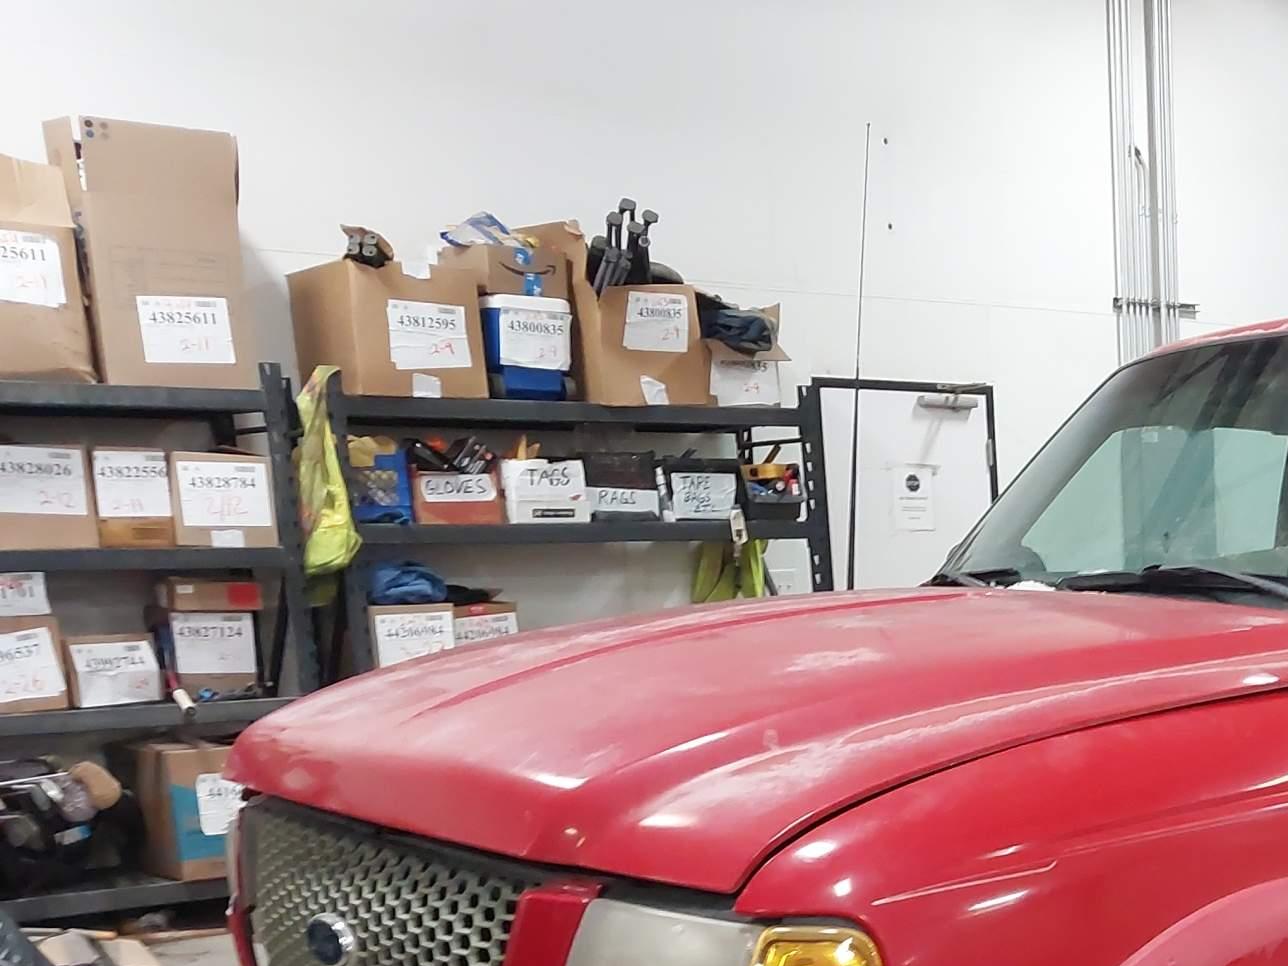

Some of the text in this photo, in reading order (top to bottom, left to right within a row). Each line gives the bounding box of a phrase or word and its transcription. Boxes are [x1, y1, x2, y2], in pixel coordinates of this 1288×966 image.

[148, 311, 218, 325] 43825611
[397, 315, 457, 330] 43812595
[507, 320, 565, 336] 43800835
[188, 476, 257, 489] 43828784
[527, 467, 571, 487] TAGS
[425, 478, 488, 496] GLOVES
[598, 489, 637, 505] RAGS
